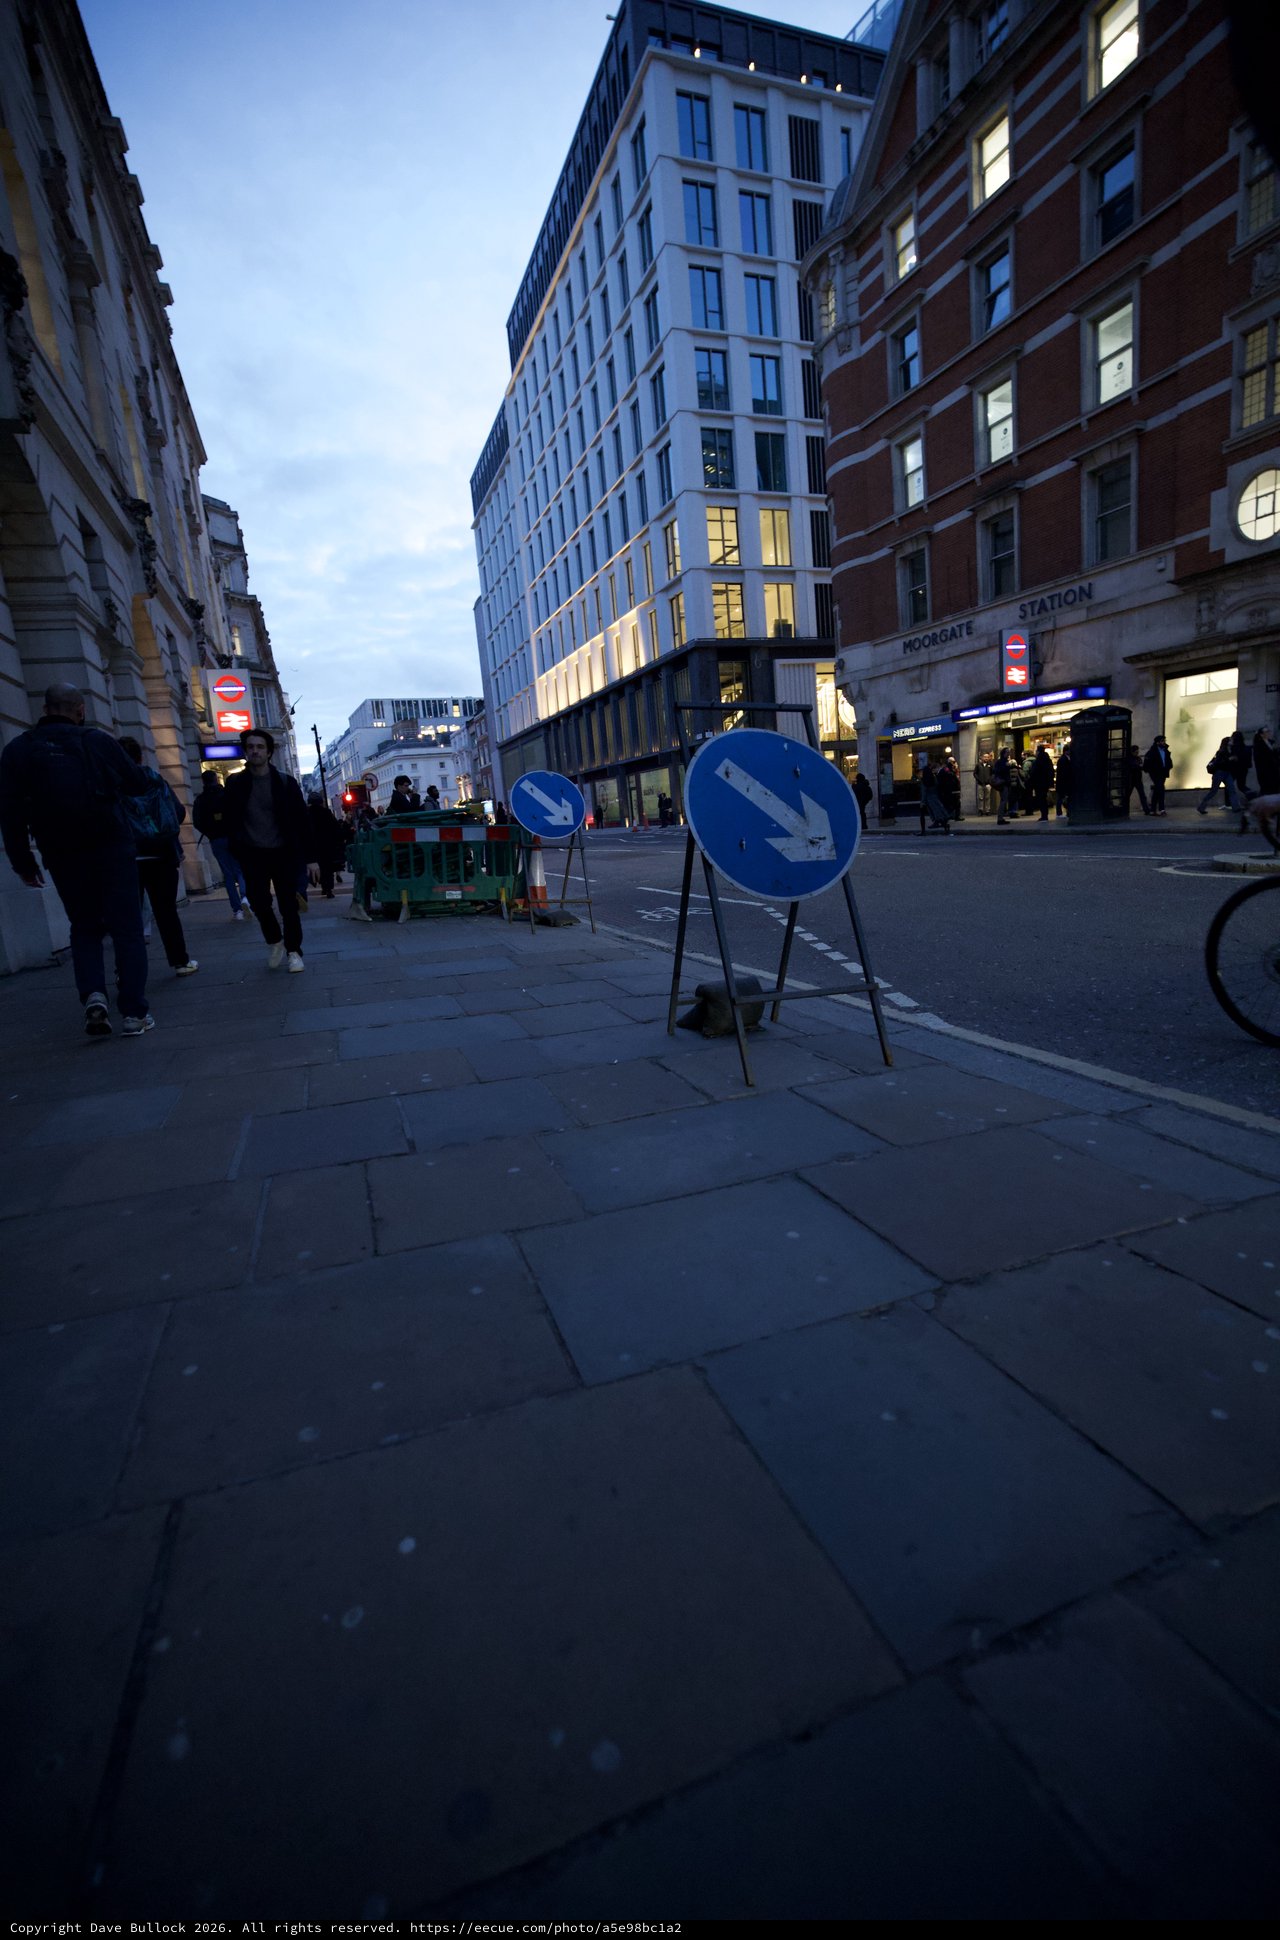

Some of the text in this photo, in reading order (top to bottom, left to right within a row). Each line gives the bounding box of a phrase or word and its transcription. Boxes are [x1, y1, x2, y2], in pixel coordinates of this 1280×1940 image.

[903, 582, 1093, 654] MOORGATE STATION
[893, 724, 942, 738] NERO EXPRESS
